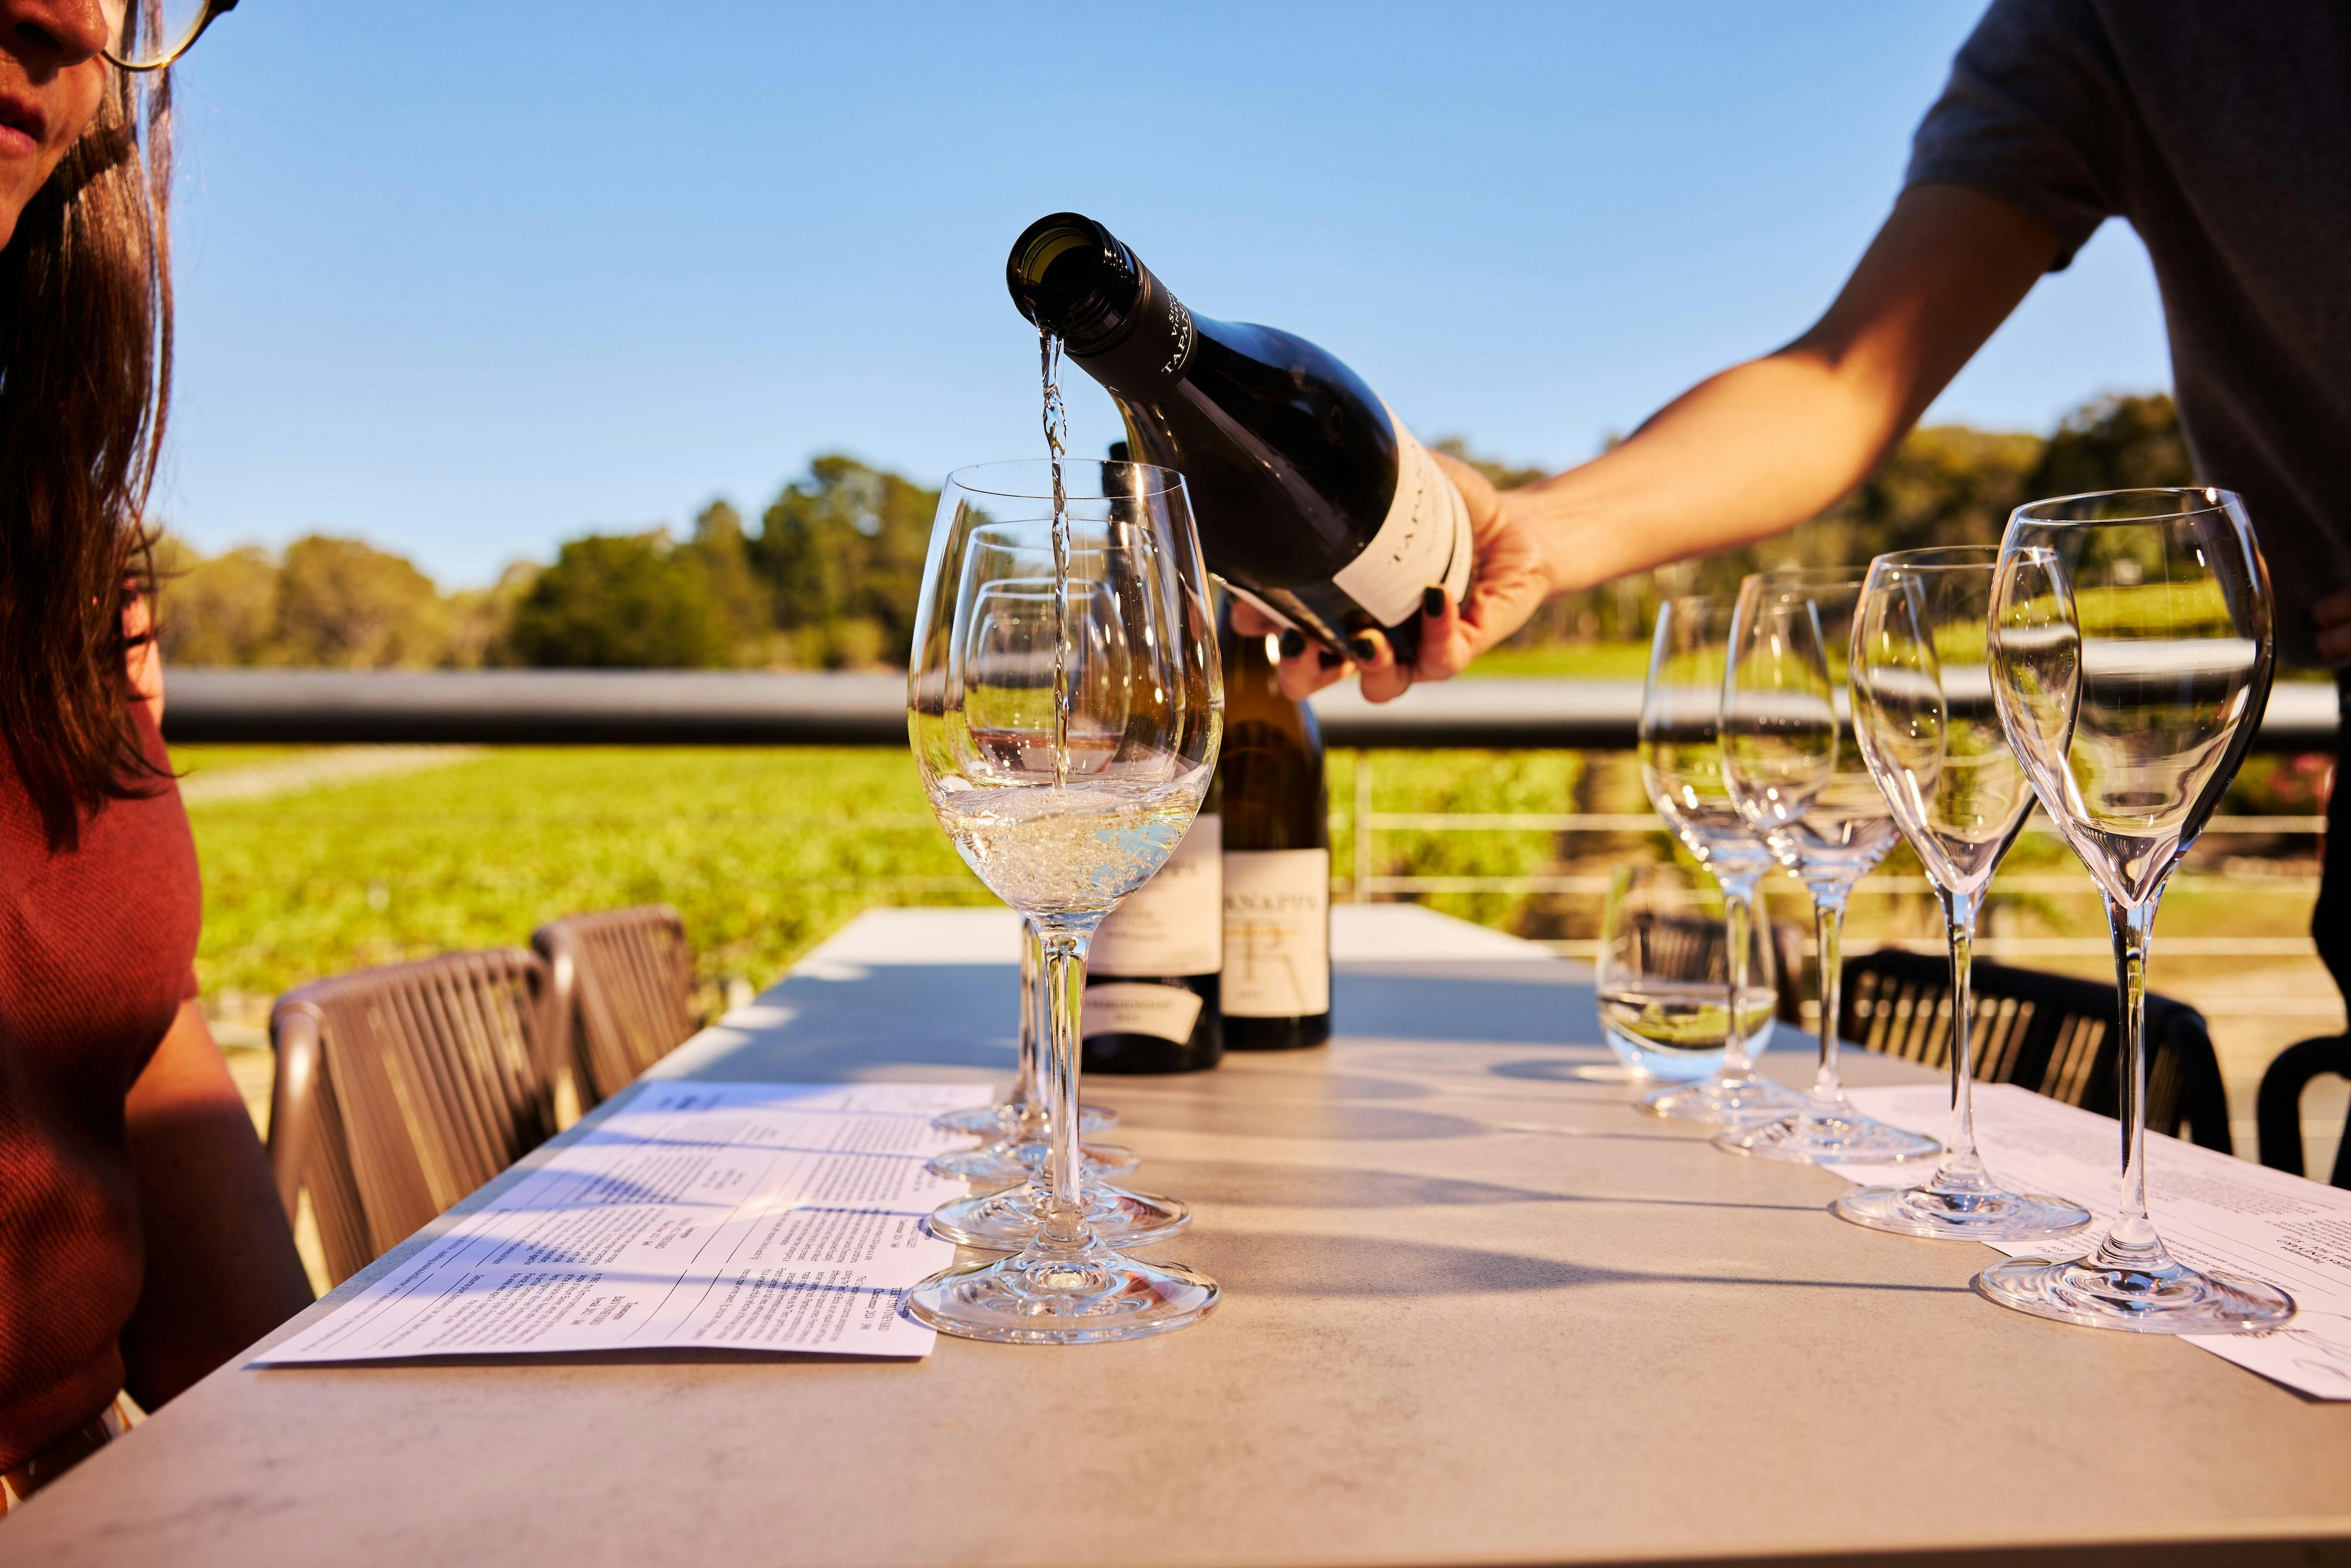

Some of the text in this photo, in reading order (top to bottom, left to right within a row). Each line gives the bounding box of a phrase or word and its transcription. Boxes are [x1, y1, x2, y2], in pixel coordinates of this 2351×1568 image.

[585, 1296, 606, 1307] Syrah
[865, 1288, 883, 1309] Chardonnay
[889, 1287, 902, 1298] TIERS
[588, 1305, 617, 1325] VINEYARD
[609, 1302, 638, 1320] Tapanappa
